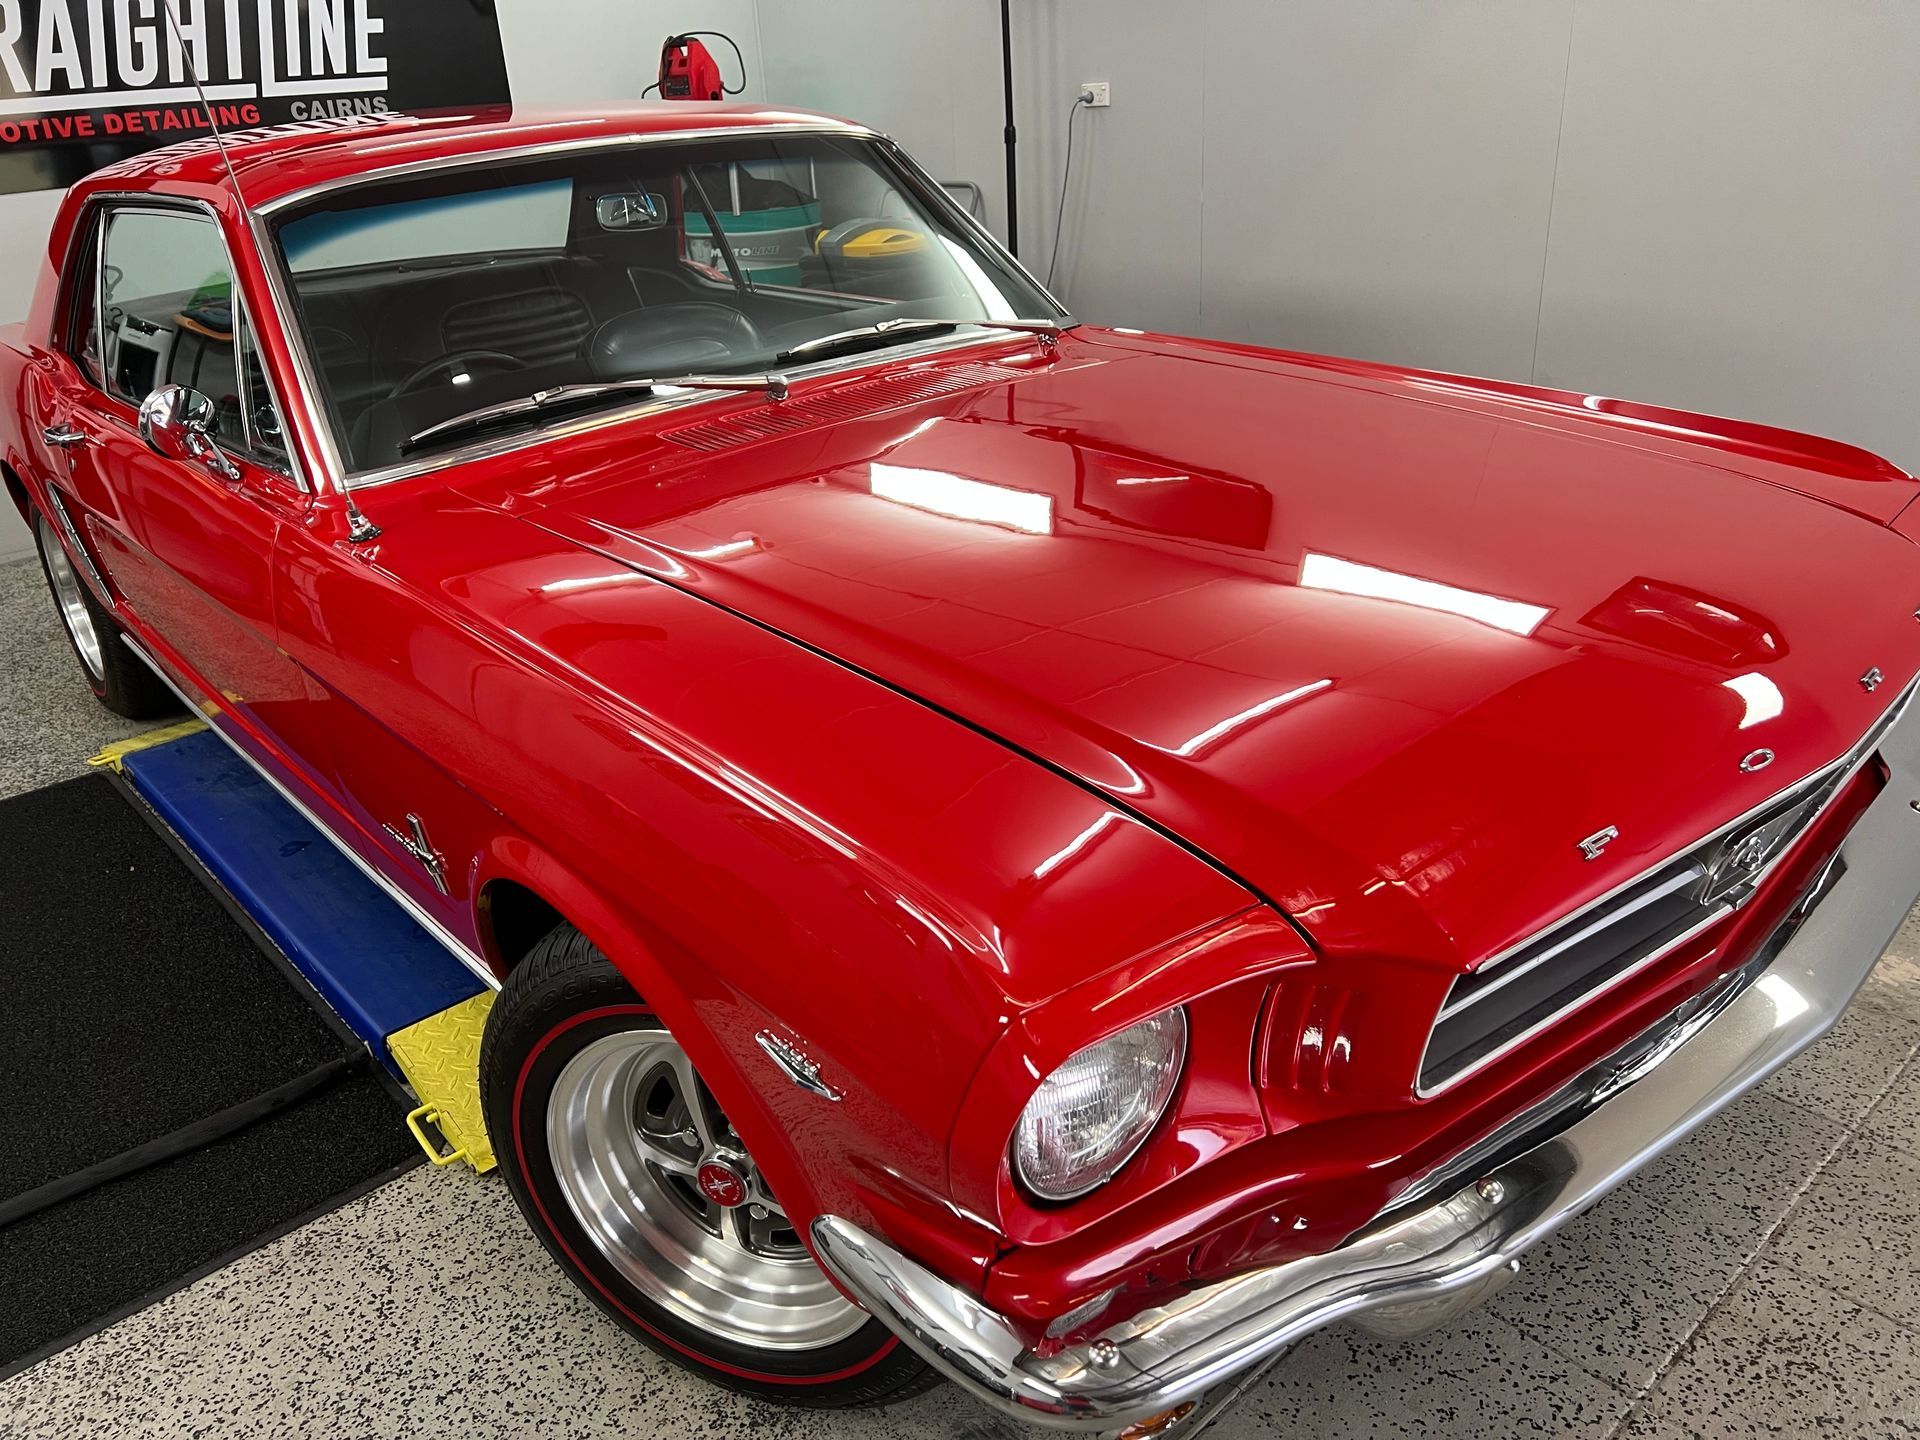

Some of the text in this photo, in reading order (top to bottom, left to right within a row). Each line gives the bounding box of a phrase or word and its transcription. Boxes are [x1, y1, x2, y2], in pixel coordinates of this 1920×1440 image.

[0, 96, 389, 143] OTIVE DETAILING CAIRNS
[710, 245, 780, 258] MTOLINE
